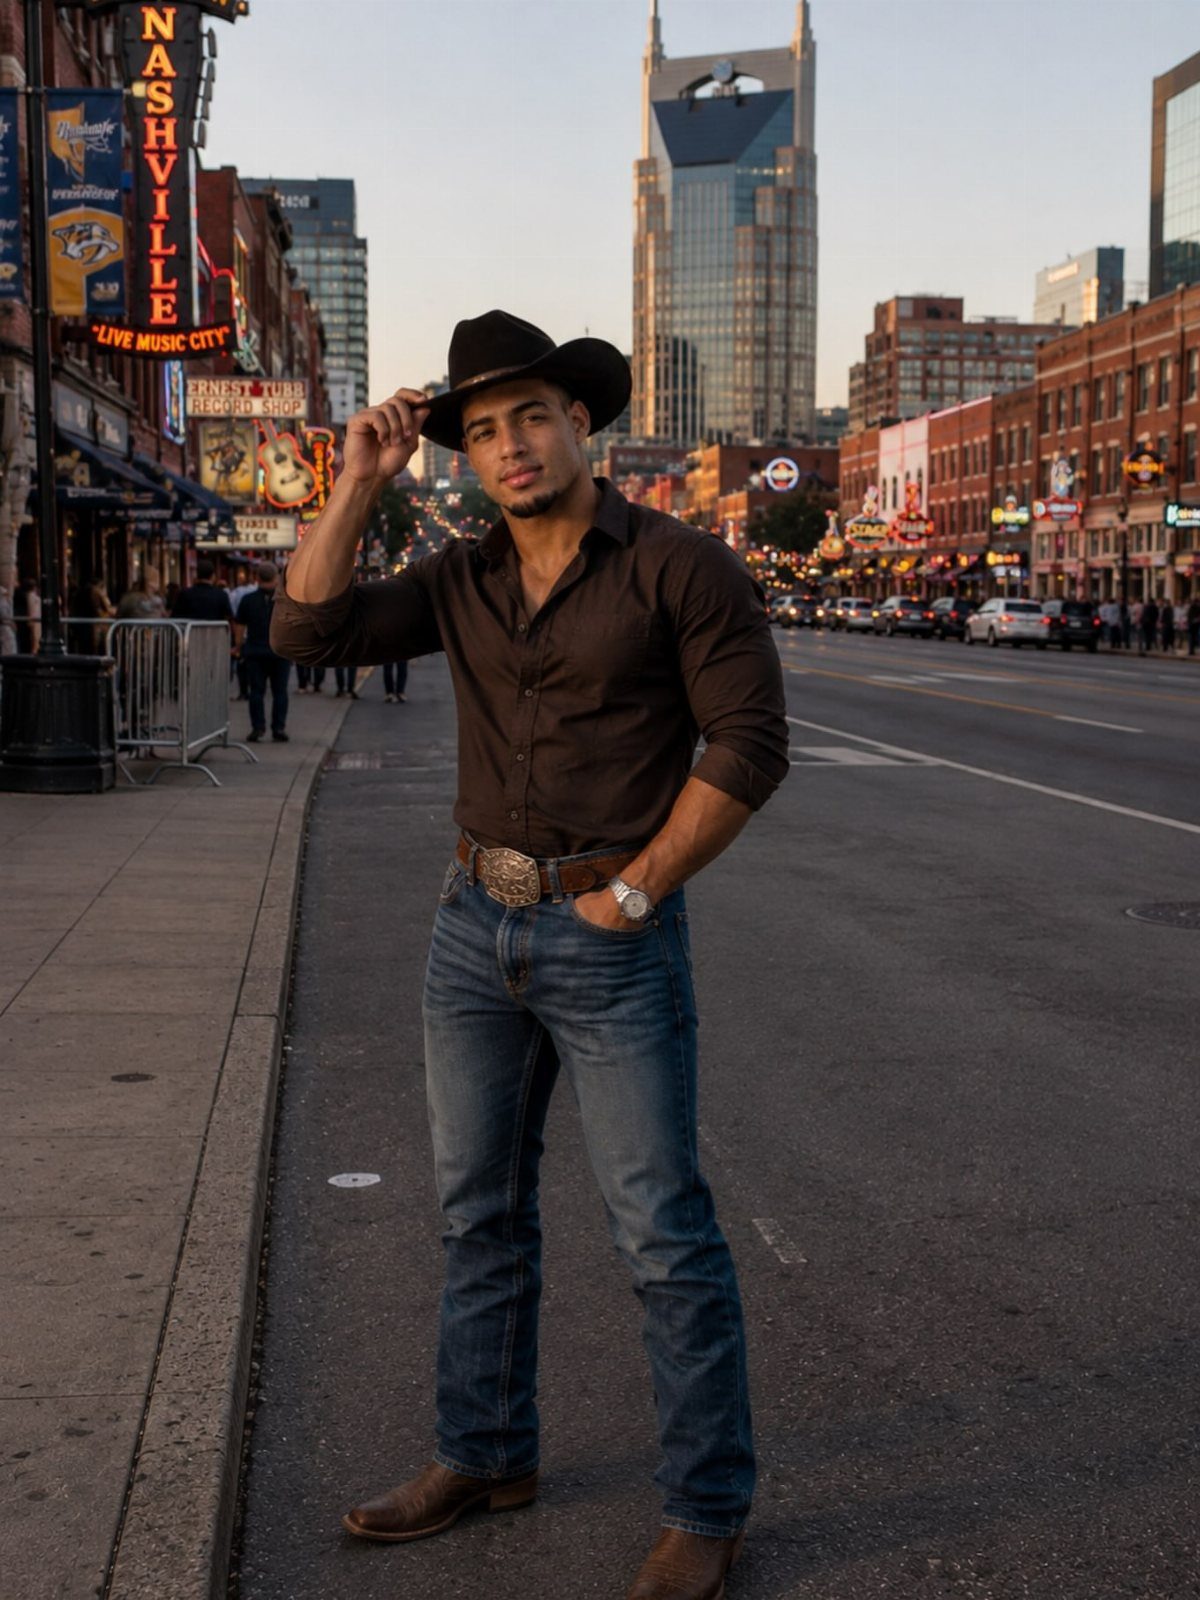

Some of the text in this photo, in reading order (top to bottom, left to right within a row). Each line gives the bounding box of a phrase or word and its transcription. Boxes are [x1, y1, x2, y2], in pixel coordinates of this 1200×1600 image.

[142, 7, 177, 324] NASHVILLE
[136, 333, 186, 351] MUSIC
[188, 380, 304, 398] ERNEST TUBB
[192, 399, 301, 415] RECORD SHOP
